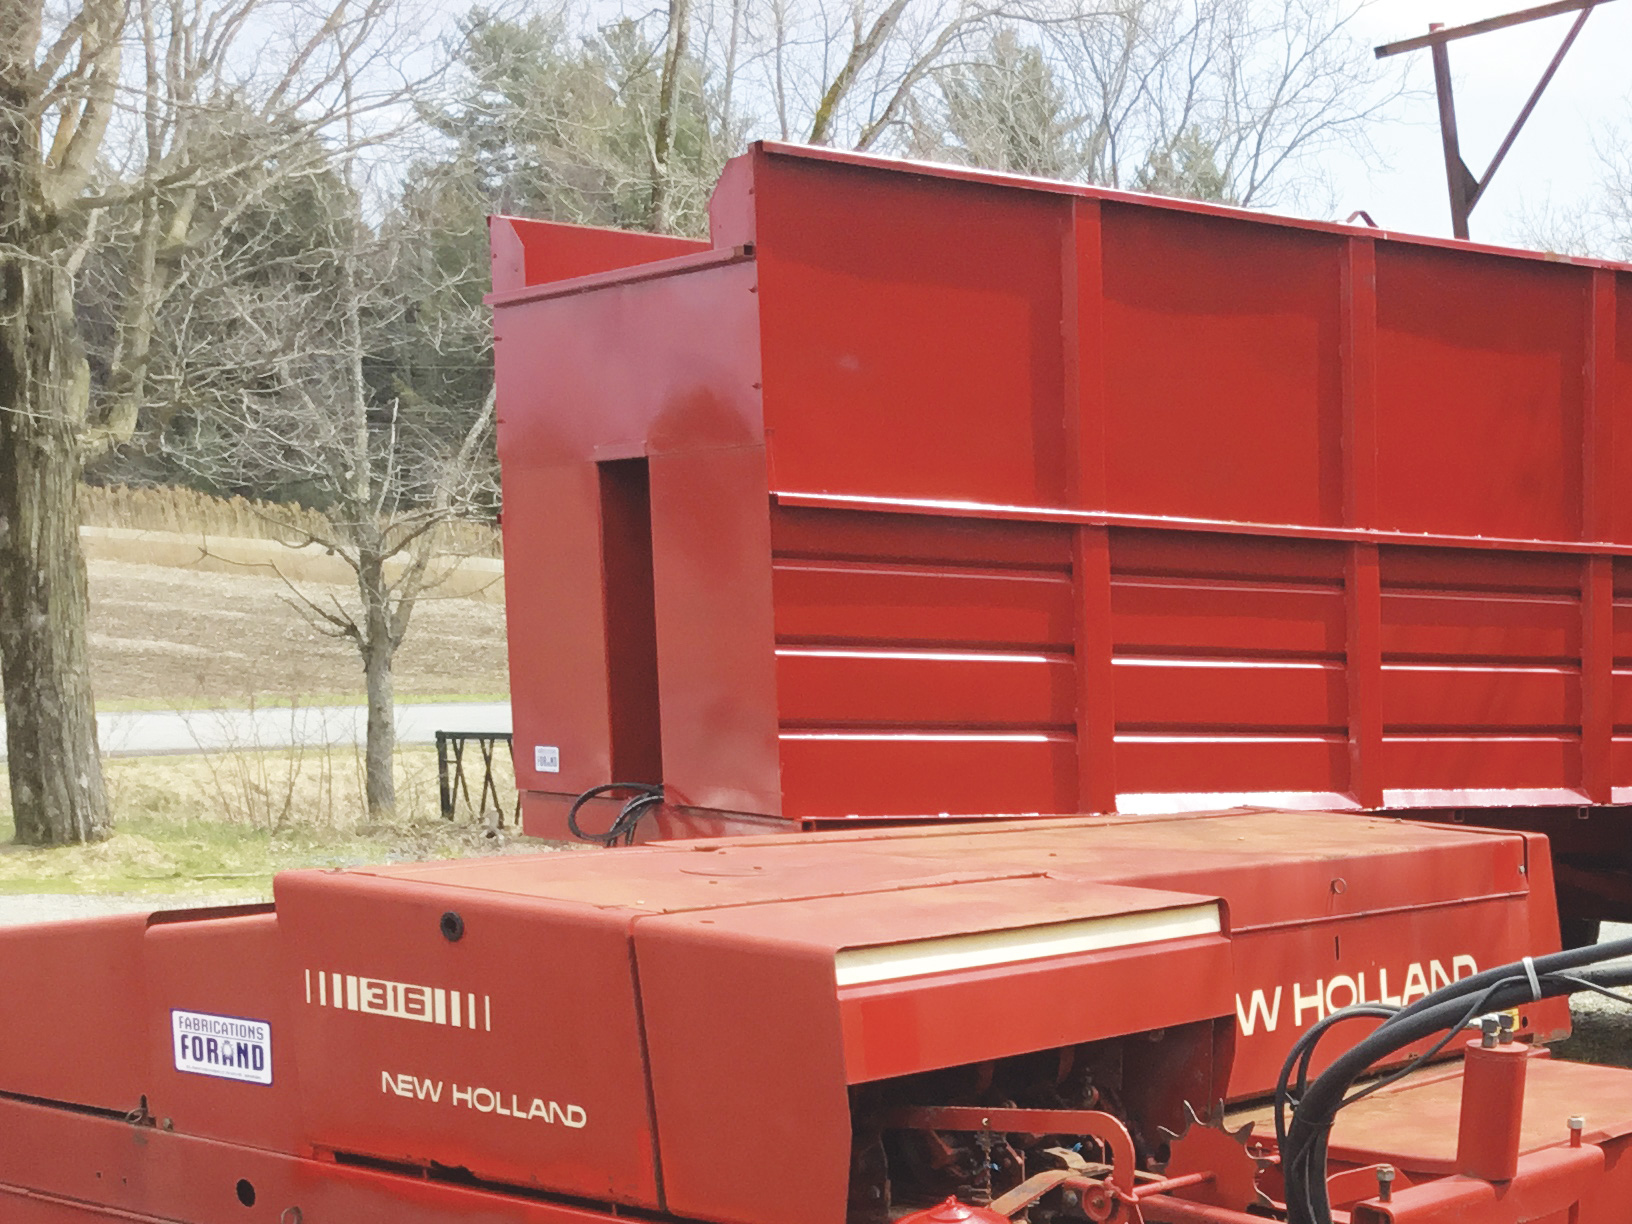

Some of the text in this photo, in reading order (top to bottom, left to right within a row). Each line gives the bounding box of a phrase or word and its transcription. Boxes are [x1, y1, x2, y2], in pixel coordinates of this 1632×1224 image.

[365, 980, 426, 1017] 316
[1236, 986, 1282, 1036] W
[179, 1016, 264, 1040] FABRICATIONS
[181, 1034, 264, 1071] FORAND
[382, 1071, 587, 1128] NEW HOLLAND
